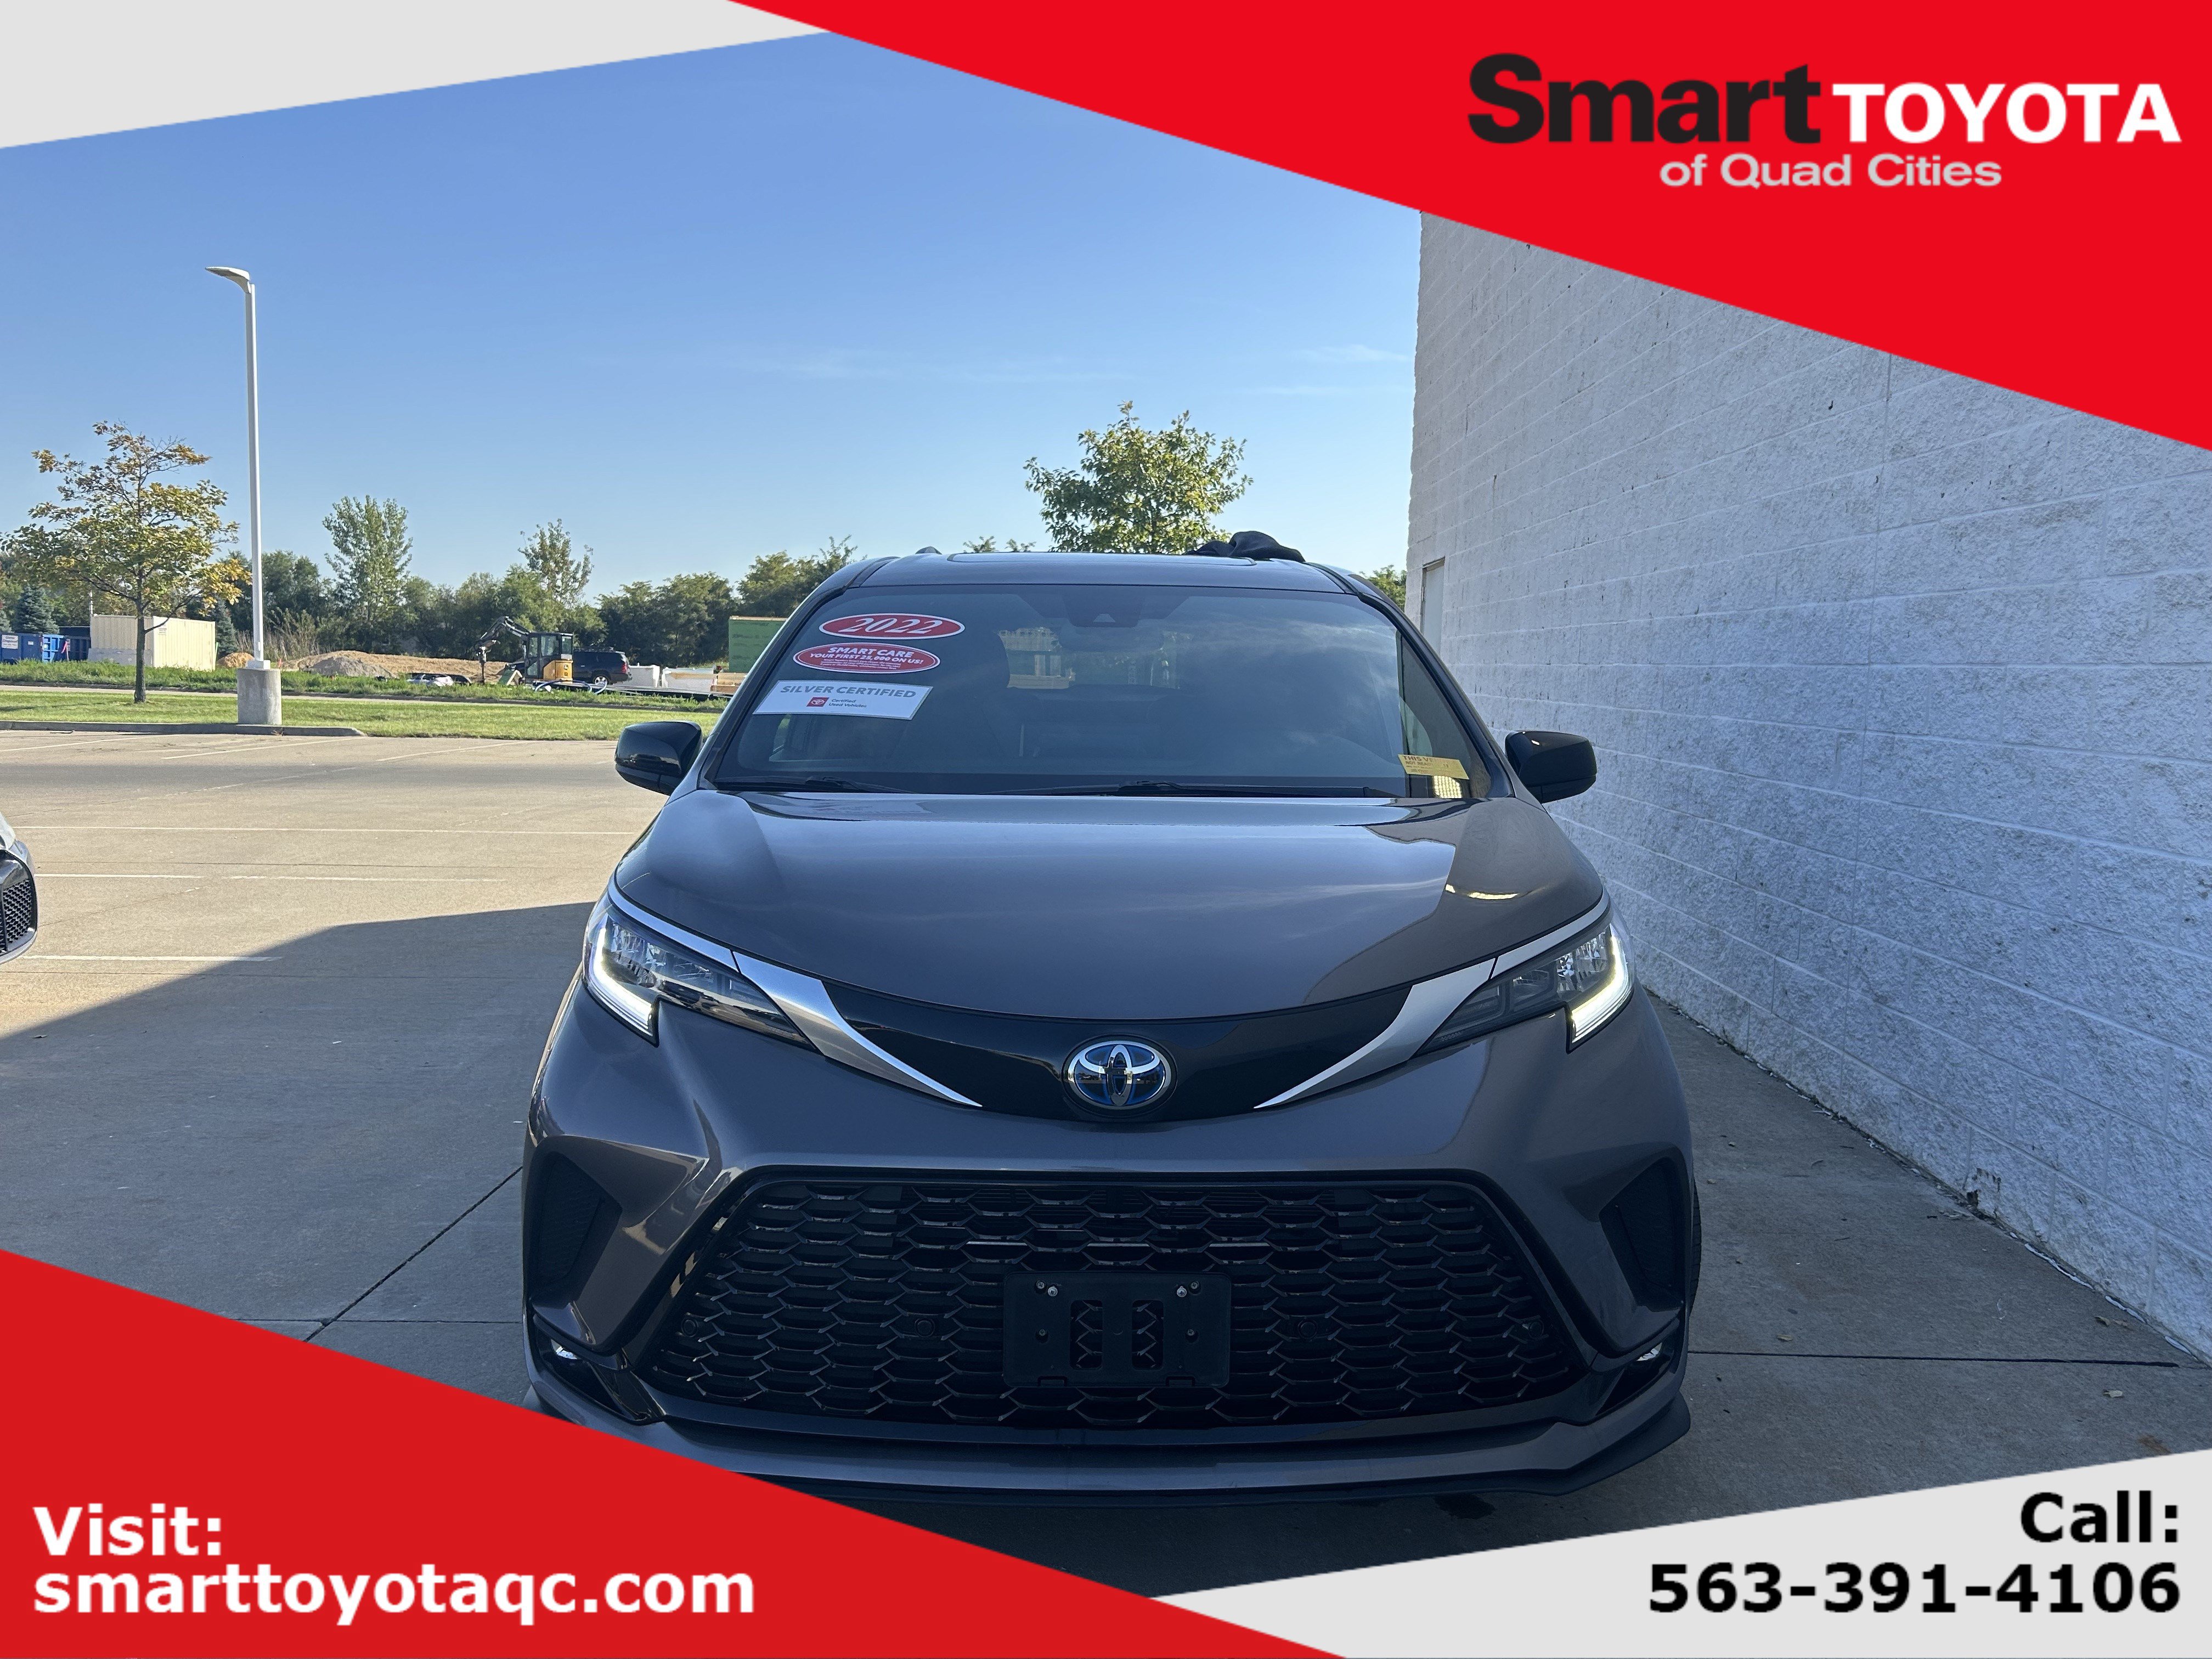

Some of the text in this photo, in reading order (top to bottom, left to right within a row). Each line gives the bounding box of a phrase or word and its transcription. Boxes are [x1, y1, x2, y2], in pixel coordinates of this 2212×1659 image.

[838, 618, 943, 634] 2022
[827, 647, 915, 658] SMART CARE
[780, 685, 916, 697] SILVER CERTIFIED
